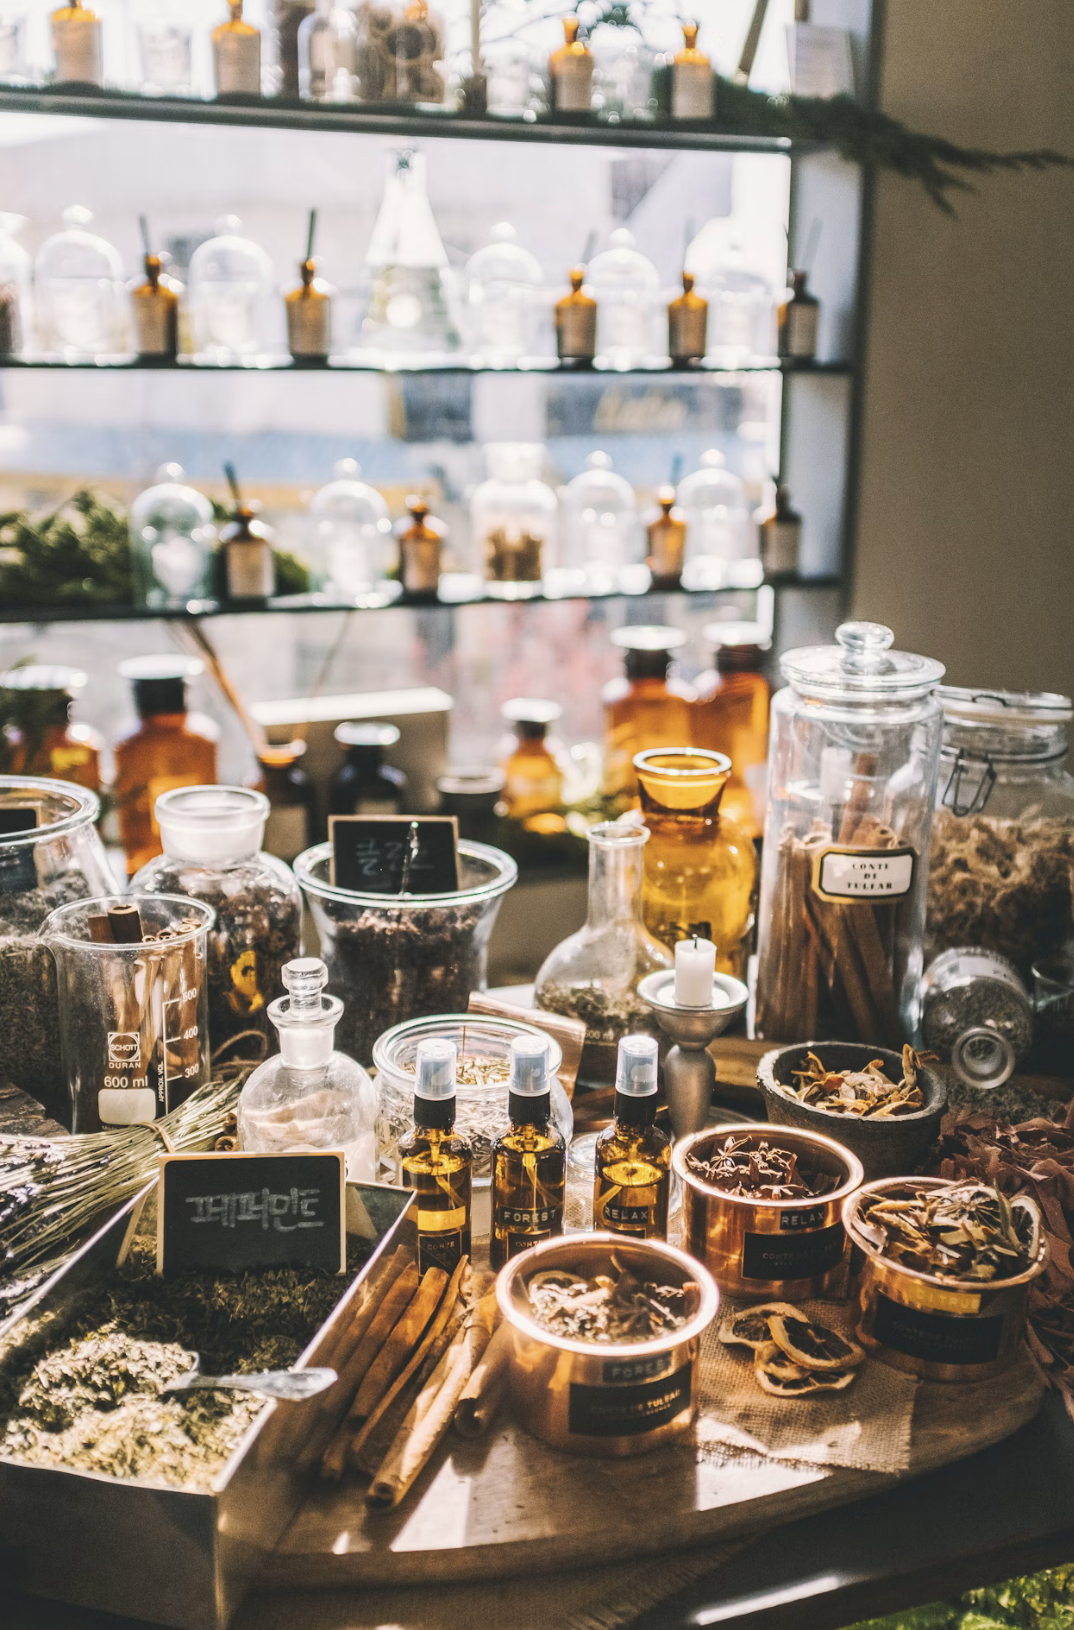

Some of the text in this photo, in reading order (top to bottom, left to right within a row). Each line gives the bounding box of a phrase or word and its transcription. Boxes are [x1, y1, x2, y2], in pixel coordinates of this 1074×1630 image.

[852, 862, 889, 871] CONTE
[864, 872, 878, 880] DE
[847, 882, 893, 890] TULEAR
[182, 987, 198, 1002] 500
[183, 1025, 199, 1040] 400
[110, 1043, 138, 1052] SCHOTT
[109, 1061, 141, 1070] DURAN
[184, 1062, 200, 1079] 300
[103, 1075, 149, 1088] 600 ml
[185, 1187, 325, 1233] 페퍼민트
[504, 1209, 556, 1223] FOREST
[604, 1206, 648, 1220] RELAX
[781, 1211, 825, 1226] RELAX
[427, 1240, 455, 1250] CONTE
[515, 1239, 543, 1248] CONT
[611, 1357, 671, 1378] FORES
